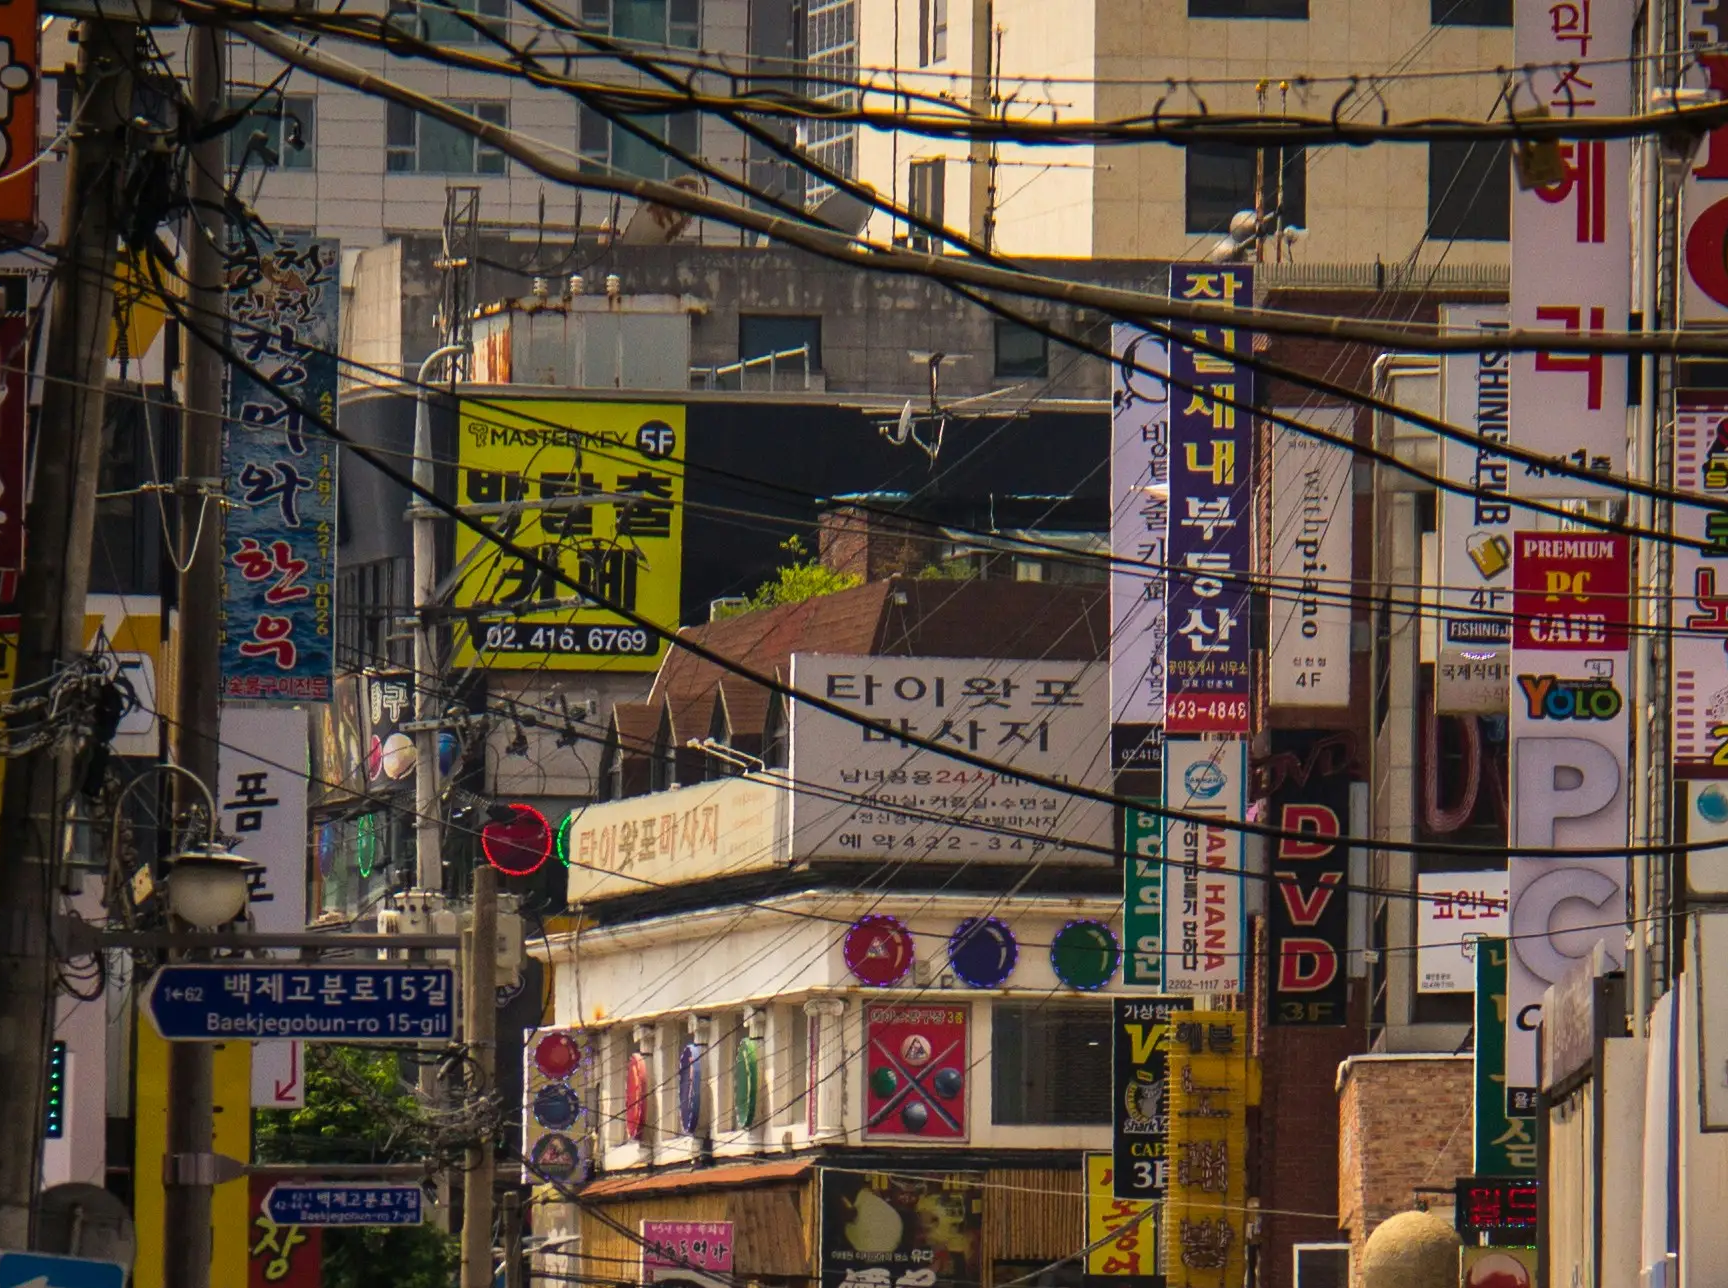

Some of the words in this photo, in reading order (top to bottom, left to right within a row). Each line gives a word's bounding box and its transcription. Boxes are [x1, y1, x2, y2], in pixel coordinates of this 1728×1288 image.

[640, 429, 675, 456] 5F
[1522, 539, 1615, 560] PREMIUM
[1544, 570, 1592, 603] PC
[1528, 613, 1607, 644] CAFE
[220, 676, 330, 698] 숯불구이전문
[825, 673, 1085, 710] 타이왓포
[1294, 671, 1323, 689] 4F
[1516, 674, 1623, 722] YOLO
[860, 716, 1050, 753] 마사지
[1275, 803, 1342, 993] DVD
[223, 973, 448, 1007] 백제고분로15길
[206, 1011, 381, 1036] Baekjegobun-ro
[387, 1013, 448, 1037] 15-gil
